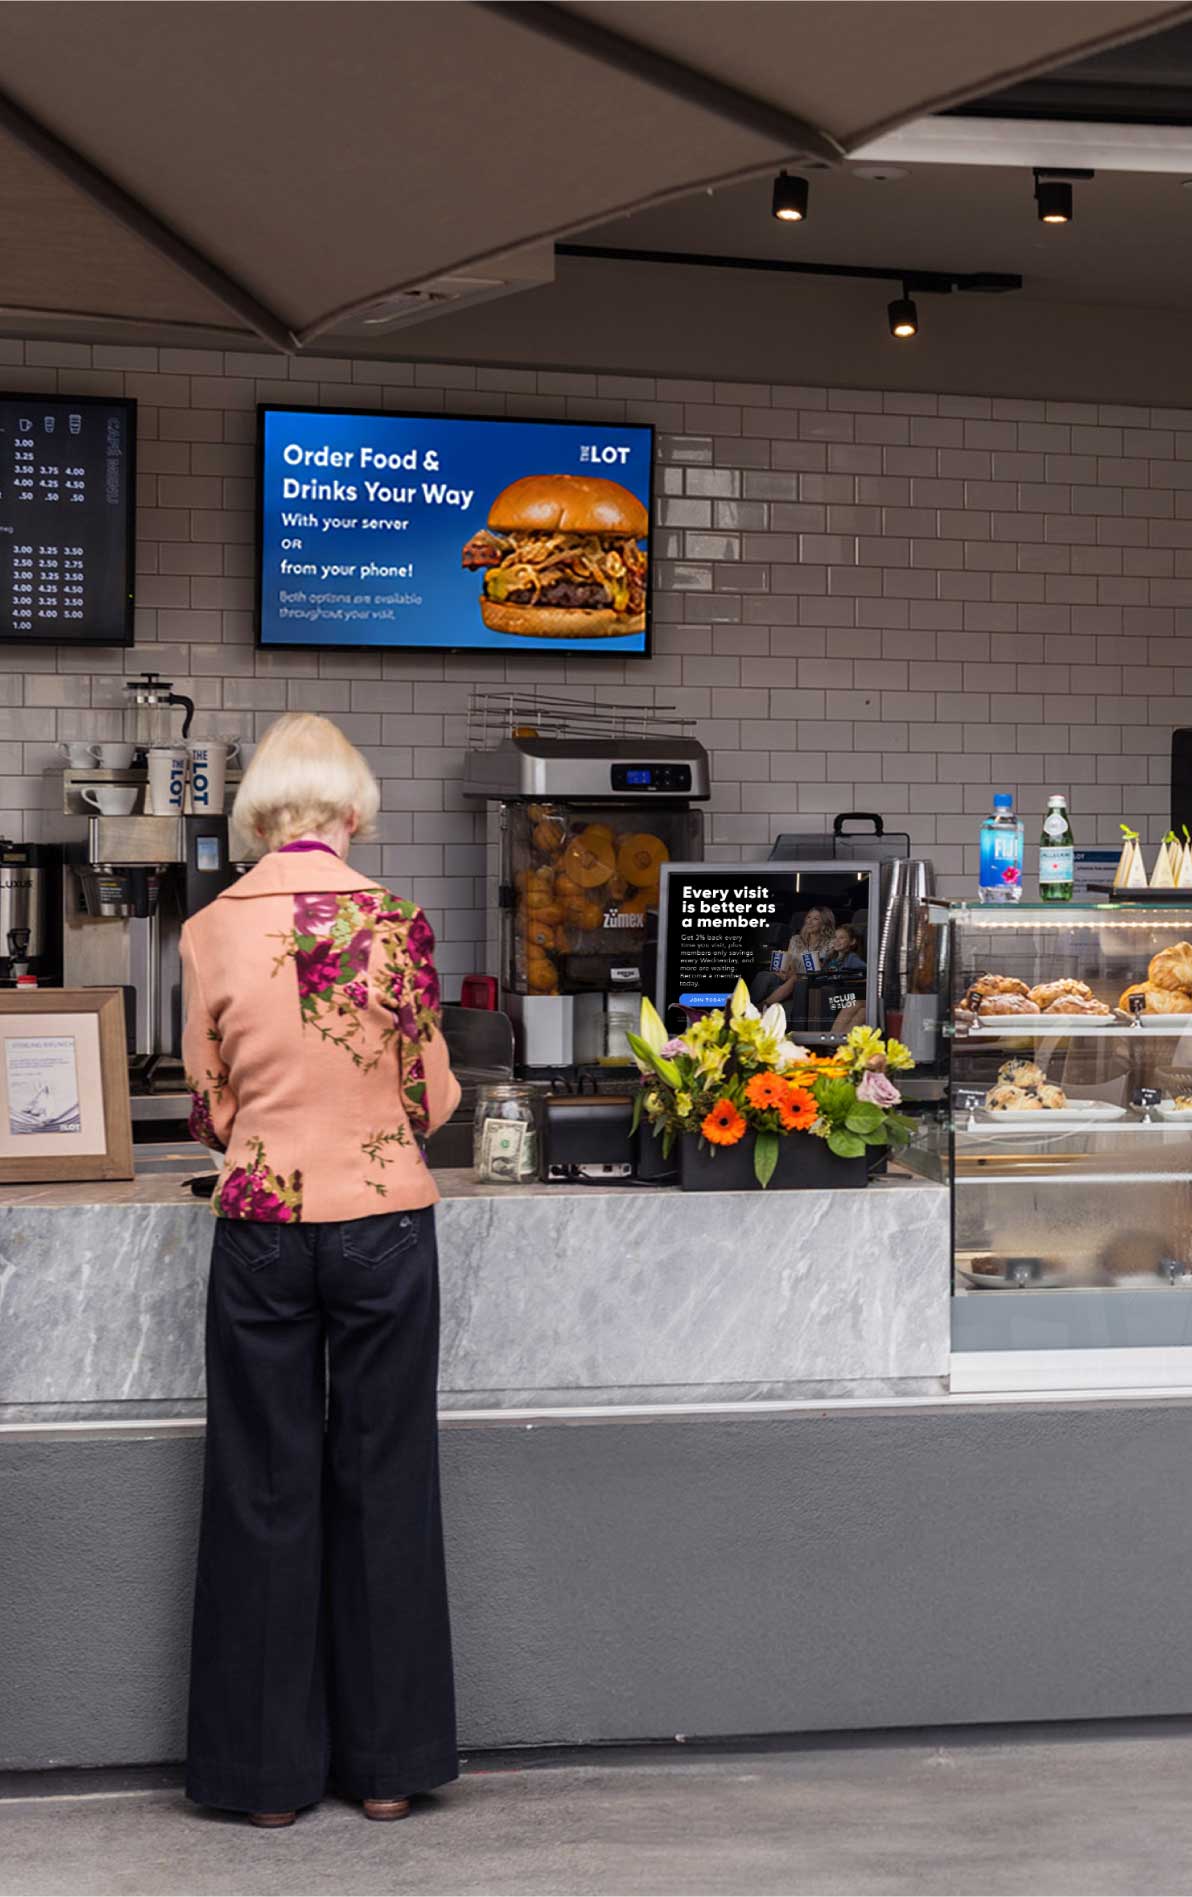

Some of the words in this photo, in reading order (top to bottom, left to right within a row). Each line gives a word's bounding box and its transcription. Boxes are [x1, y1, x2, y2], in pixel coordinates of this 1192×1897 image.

[14, 439, 34, 447] 3.00
[15, 452, 34, 460] 3.25
[283, 444, 354, 467] Order
[360, 448, 417, 470] Food
[423, 450, 439, 471] &
[591, 445, 630, 464] LOT
[14, 465, 34, 474] 3.50
[40, 466, 58, 475] 3.75
[65, 467, 85, 476] 4.00
[13, 479, 34, 487] 4.00
[40, 480, 58, 488] 4.25
[65, 481, 85, 489] 4.50
[19, 492, 34, 500] .50
[45, 493, 59, 501] .50
[70, 494, 85, 502] .50
[283, 478, 357, 502] Drinks
[364, 482, 416, 503] Your
[422, 484, 474, 510] Way
[281, 513, 318, 527] With
[322, 516, 357, 531] your
[361, 518, 409, 530] server
[281, 539, 302, 550] OR
[13, 545, 33, 554] 3.00
[39, 546, 58, 555] 3.25
[64, 547, 84, 556] 3.50
[13, 559, 33, 567] 2.50
[39, 559, 58, 568] 2.50
[64, 560, 83, 569] 2.75
[280, 559, 317, 575] from
[321, 564, 357, 579] your
[360, 562, 413, 579] phone!
[13, 571, 33, 580] 3.00
[40, 572, 59, 580] 3.25
[64, 573, 84, 581] 3.50
[12, 584, 32, 592] 4.00
[38, 585, 57, 593] 4.25
[63, 585, 83, 594] 4.50
[13, 596, 32, 605] 3.00
[38, 597, 57, 605] 3.25
[64, 598, 83, 606] 3.50
[280, 591, 306, 603] Both
[308, 593, 351, 604] options
[353, 596, 371, 604] are
[374, 592, 422, 605] available
[12, 609, 32, 617] 4.00
[38, 610, 57, 618] 4.00
[64, 610, 83, 619] 5.00
[279, 607, 342, 620] throughout
[342, 609, 369, 620] your
[12, 621, 32, 630] 1.00
[192, 750, 208, 760] THE
[169, 770, 183, 808] LOT
[192, 763, 208, 806] LOT
[995, 839, 1018, 859] FIJI
[683, 886, 729, 901] Every
[734, 886, 768, 898] visit
[682, 901, 695, 913] is
[700, 901, 752, 913] better
[756, 904, 775, 913] as
[682, 919, 692, 927] a
[697, 915, 770, 928] member.
[833, 993, 856, 1003] CLUB
[842, 1000, 856, 1008] LOT
